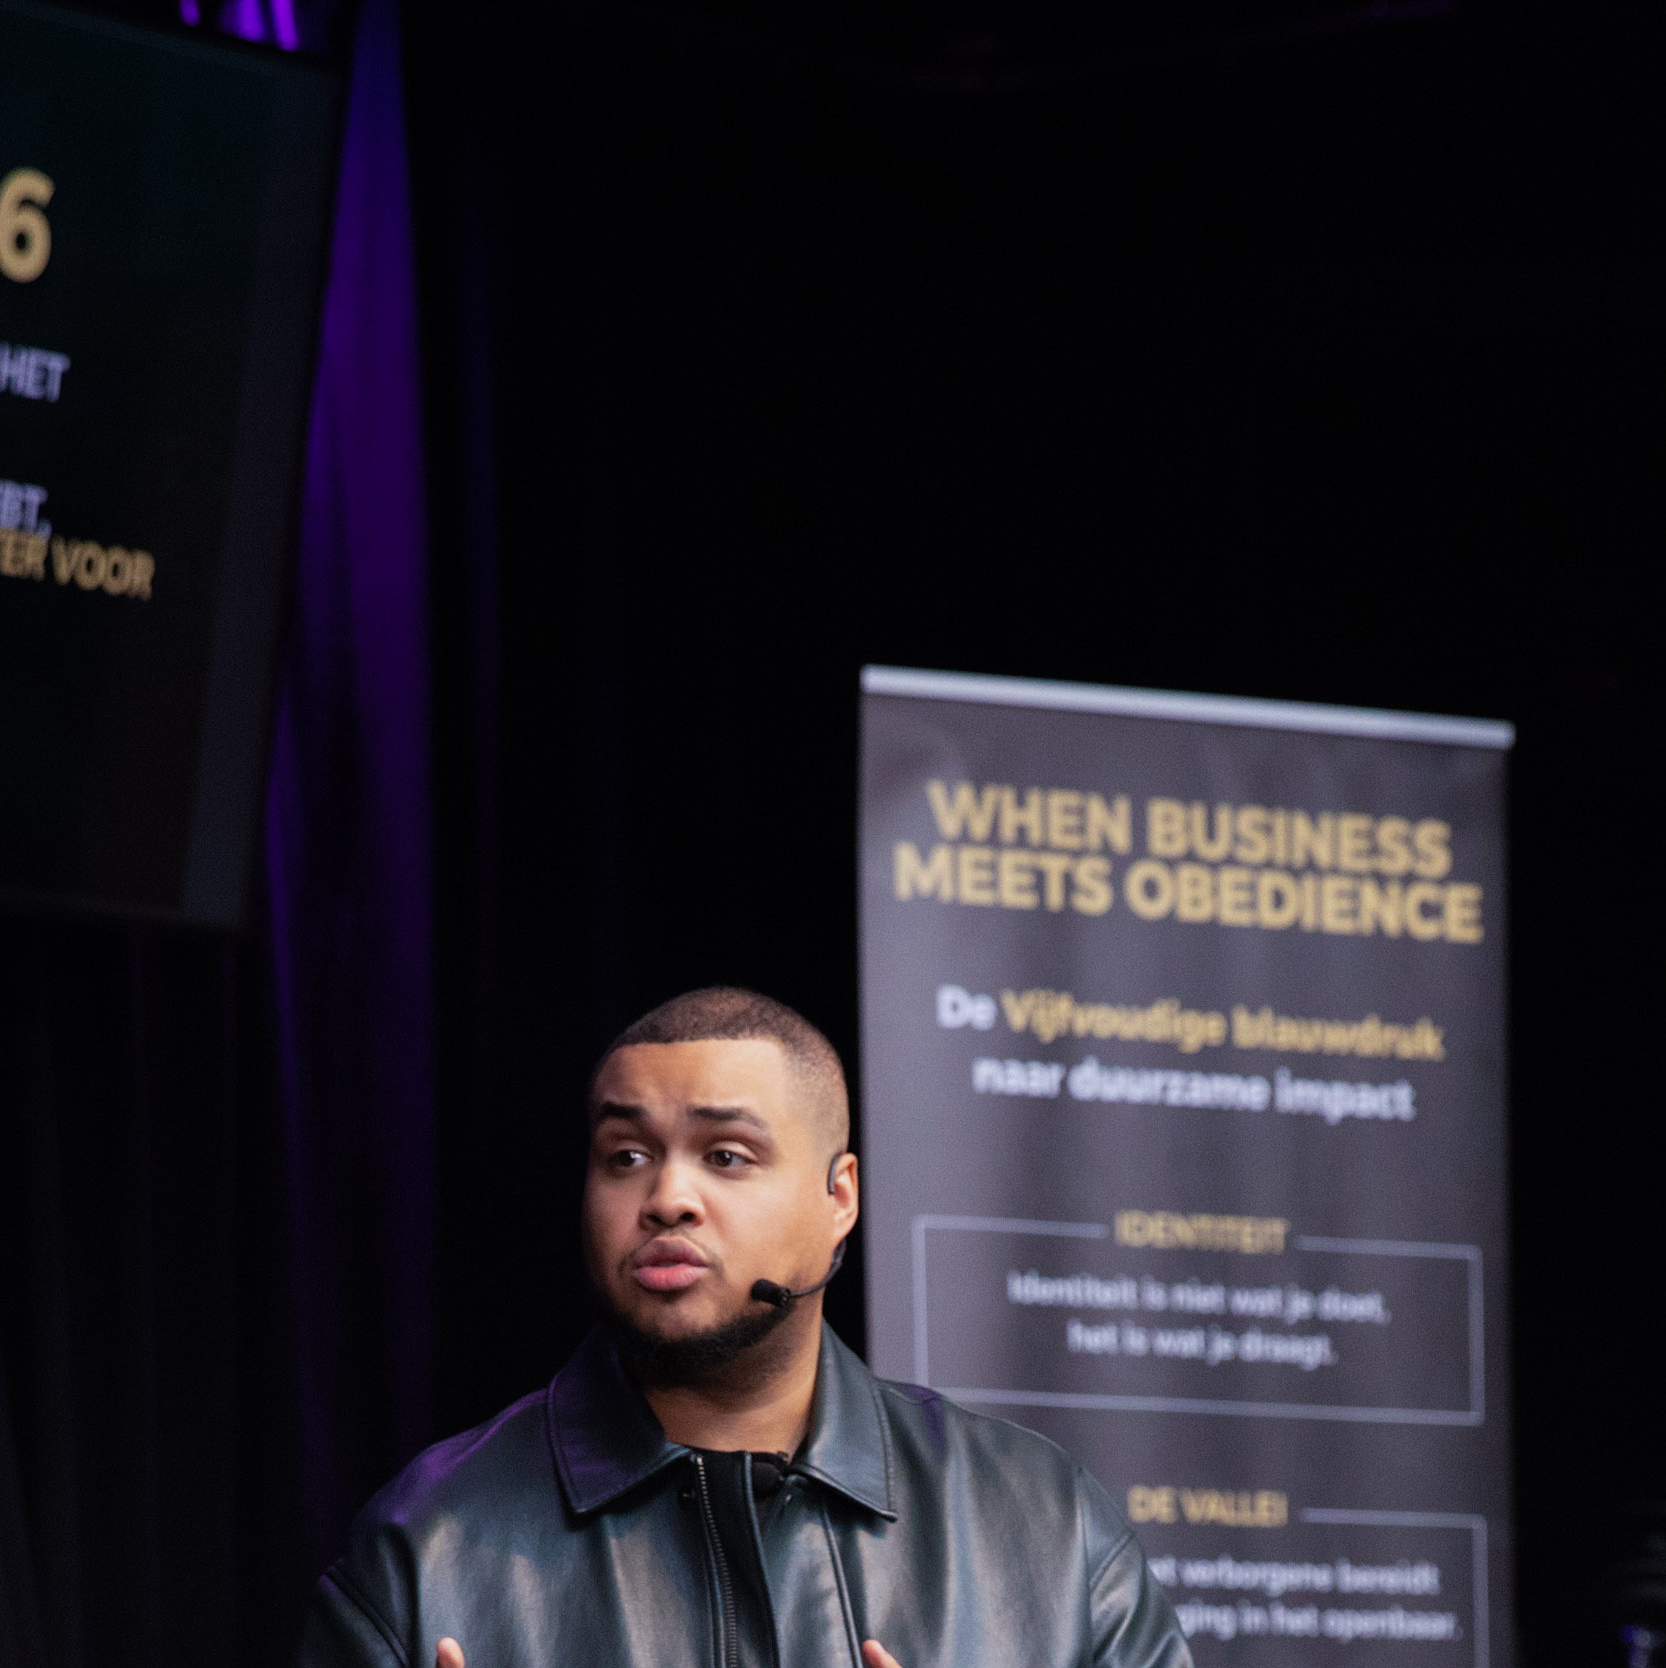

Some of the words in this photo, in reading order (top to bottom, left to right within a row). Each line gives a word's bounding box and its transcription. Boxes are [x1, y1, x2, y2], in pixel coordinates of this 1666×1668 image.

[50, 534, 156, 601] VOOR
[928, 779, 1131, 855] WHEN
[1146, 798, 1453, 880] BUSINESS
[893, 841, 1113, 916] MEETS
[1125, 861, 1484, 945] OBEDIENCE
[935, 984, 997, 1031] De
[999, 987, 1228, 1054] Vijfvoudige
[1232, 1003, 1446, 1062] blauwdruk
[971, 1056, 1066, 1098] naar
[1066, 1055, 1272, 1112] duurzame
[1273, 1067, 1417, 1126] impact
[1114, 1209, 1290, 1255] IDENTITEIT
[1006, 1268, 1137, 1309] Identiteit
[1139, 1274, 1168, 1312] is
[1168, 1276, 1225, 1314] niet
[1229, 1285, 1284, 1317] wat
[1284, 1283, 1315, 1324] je
[1067, 1317, 1118, 1355] het
[1120, 1319, 1150, 1357] is
[1152, 1326, 1205, 1358] wat
[1206, 1325, 1235, 1367] je
[1127, 1485, 1177, 1524] DE
[1180, 1488, 1289, 1528] VALLEI
[1180, 1553, 1332, 1597] verborgene
[1237, 1599, 1269, 1635] in
[1269, 1600, 1319, 1638] het
